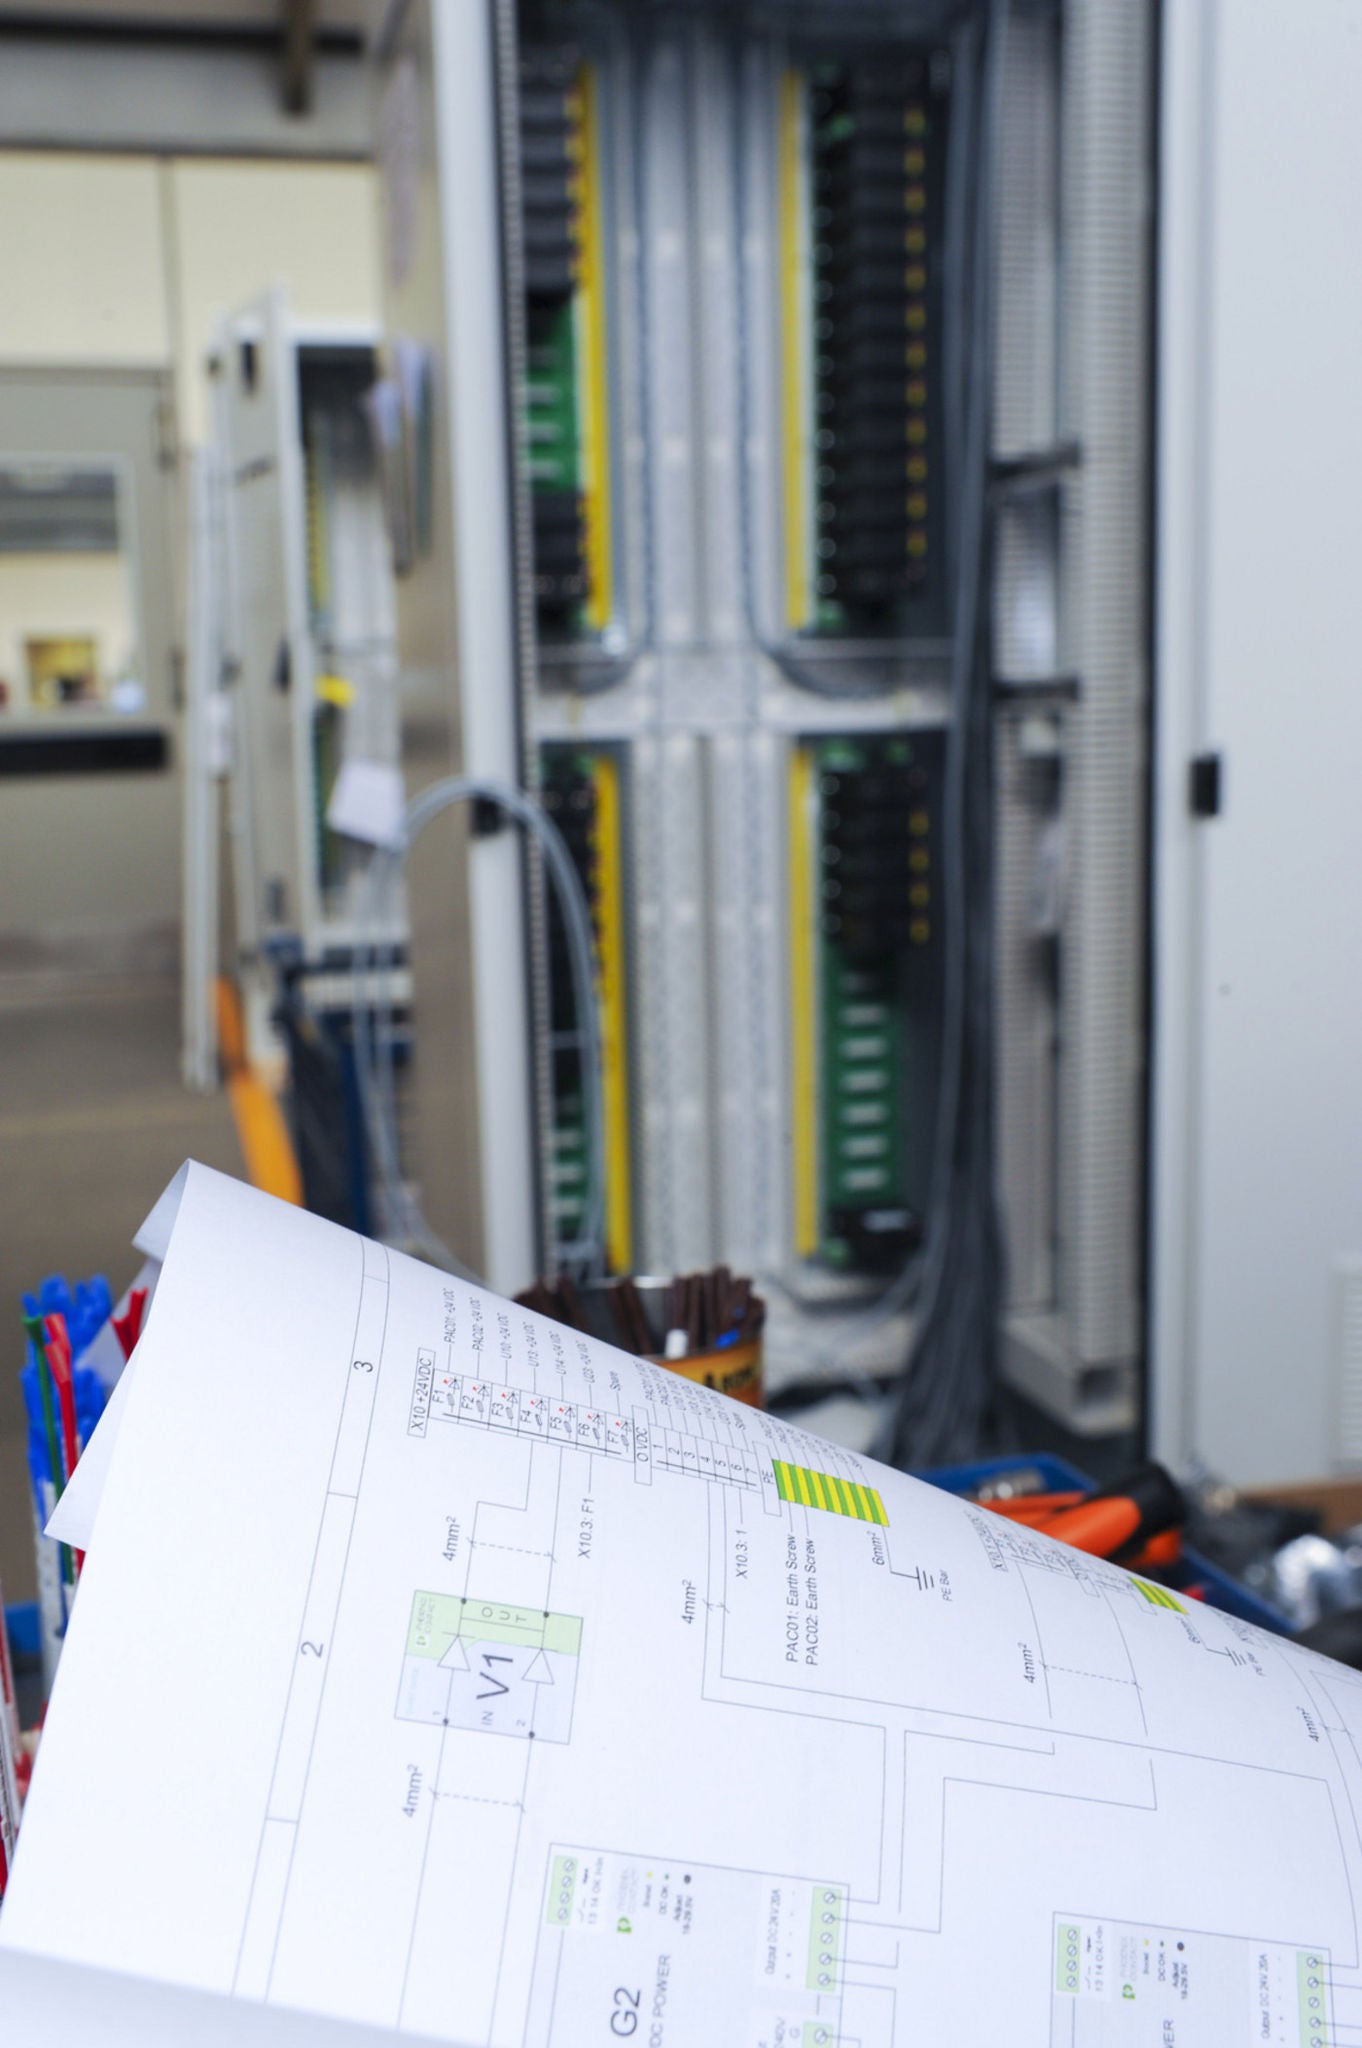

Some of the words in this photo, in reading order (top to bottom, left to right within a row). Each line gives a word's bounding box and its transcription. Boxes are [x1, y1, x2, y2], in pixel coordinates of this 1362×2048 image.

[353, 1360, 374, 1373] 3
[416, 1357, 432, 1403] +24VDC
[432, 1389, 445, 1404] F1
[461, 1395, 474, 1410] F2
[411, 1405, 427, 1431] X10
[491, 1402, 504, 1416] F3
[520, 1409, 533, 1424] F4
[550, 1416, 562, 1430] F5
[578, 1423, 590, 1436] F6
[607, 1430, 619, 1444] F7
[635, 1426, 648, 1450] VDC
[668, 1447, 680, 1455] 2
[683, 1451, 695, 1459] 3
[700, 1455, 710, 1463] 4
[714, 1460, 726, 1468] 5
[730, 1463, 742, 1471] 6
[581, 1497, 595, 1515] F1
[441, 1515, 462, 1562] 4mm²
[577, 1516, 593, 1559] X10.3:
[735, 1541, 749, 1580] X10.3:
[785, 1533, 799, 1570] Screw
[804, 1537, 817, 1574] Screw
[681, 1579, 697, 1625] 4mm²
[786, 1573, 800, 1607] Earth
[805, 1576, 819, 1611] Earth
[785, 1610, 799, 1663] PAC01:
[805, 1613, 819, 1666] PAC02:
[300, 1641, 324, 1659] 2
[1017, 1642, 1036, 1684] 4mm²
[475, 1653, 514, 1700] V1
[481, 1710, 494, 1726] IN
[515, 1719, 526, 1727] 2
[402, 1763, 423, 1819] 4mm²
[652, 1954, 671, 2018] POWER
[610, 1986, 643, 2037] G2
